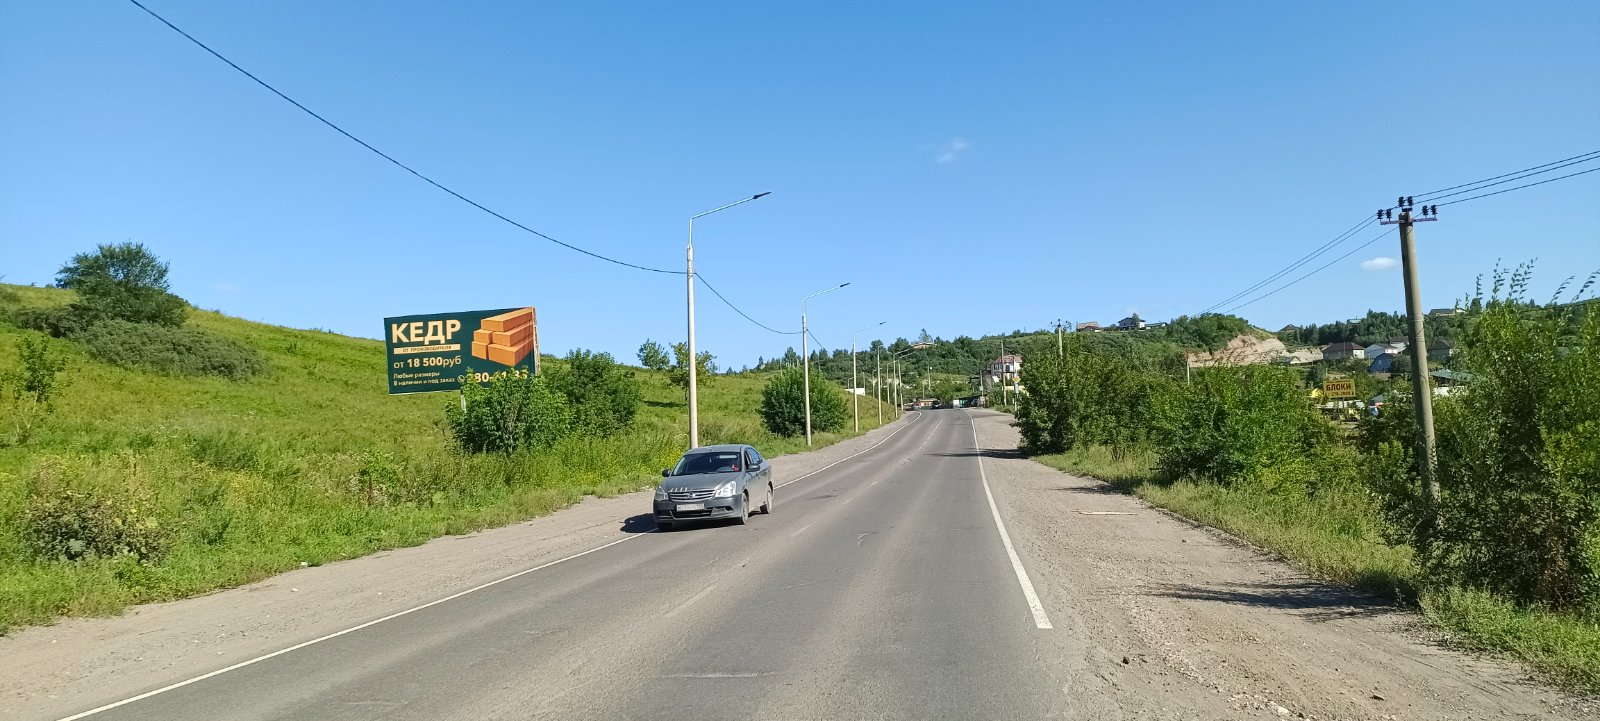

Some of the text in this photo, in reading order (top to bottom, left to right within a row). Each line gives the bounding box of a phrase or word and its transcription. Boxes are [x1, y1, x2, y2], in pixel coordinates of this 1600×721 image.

[392, 320, 461, 345] КЕДР
[407, 358, 420, 368] 18
[423, 354, 462, 368] 500руб
[1326, 383, 1351, 391] БЛОКИ
